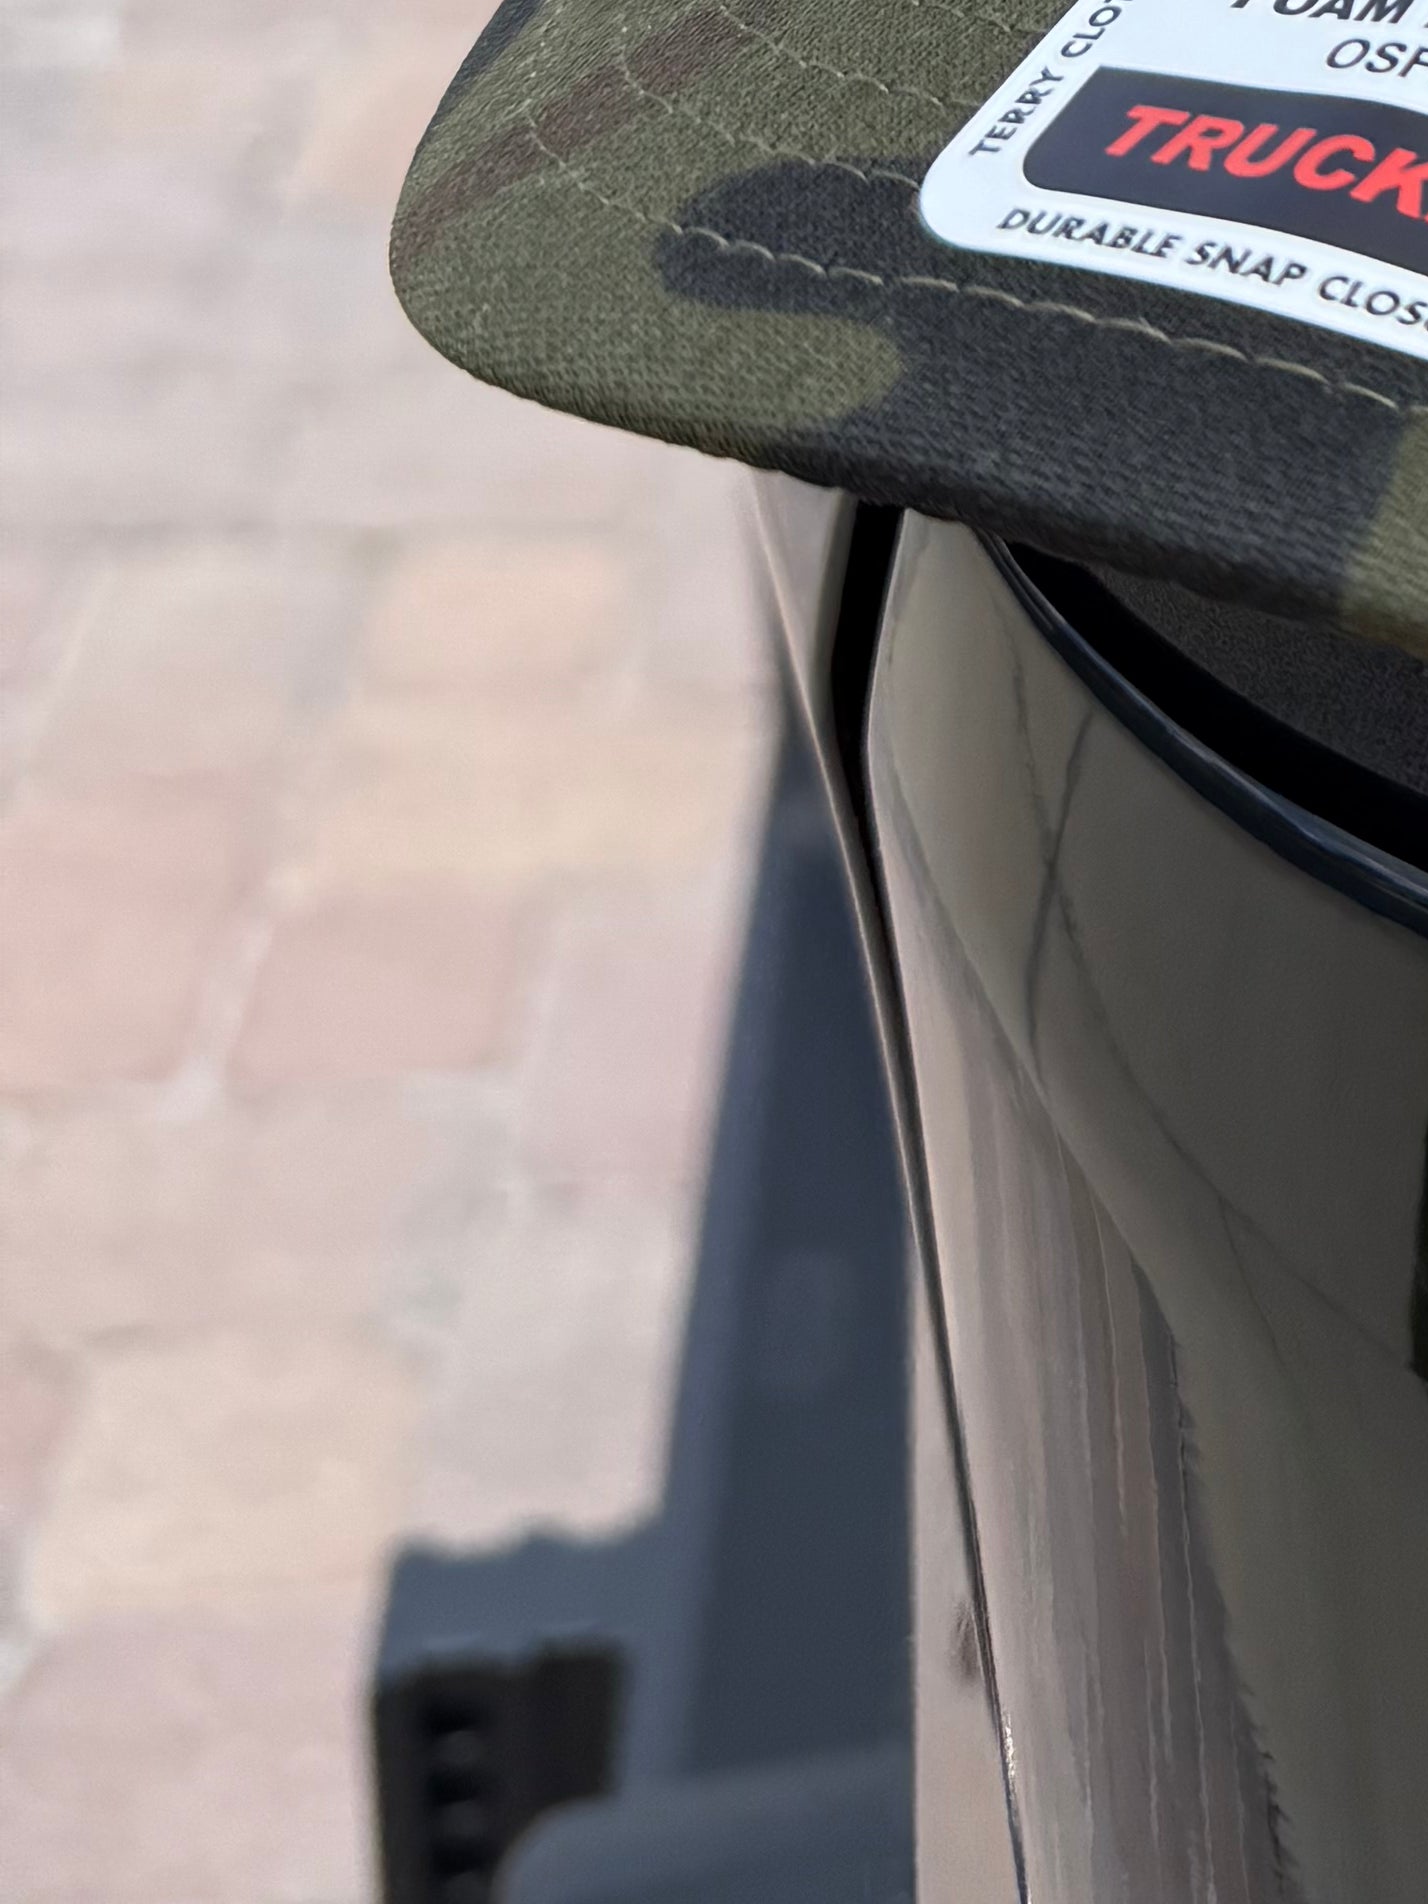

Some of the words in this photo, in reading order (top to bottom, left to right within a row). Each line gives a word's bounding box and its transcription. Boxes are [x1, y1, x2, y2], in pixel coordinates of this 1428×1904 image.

[969, 66, 1065, 159] TERRY
[996, 208, 1179, 263] DURABLE
[1185, 237, 1310, 288] SNAP
